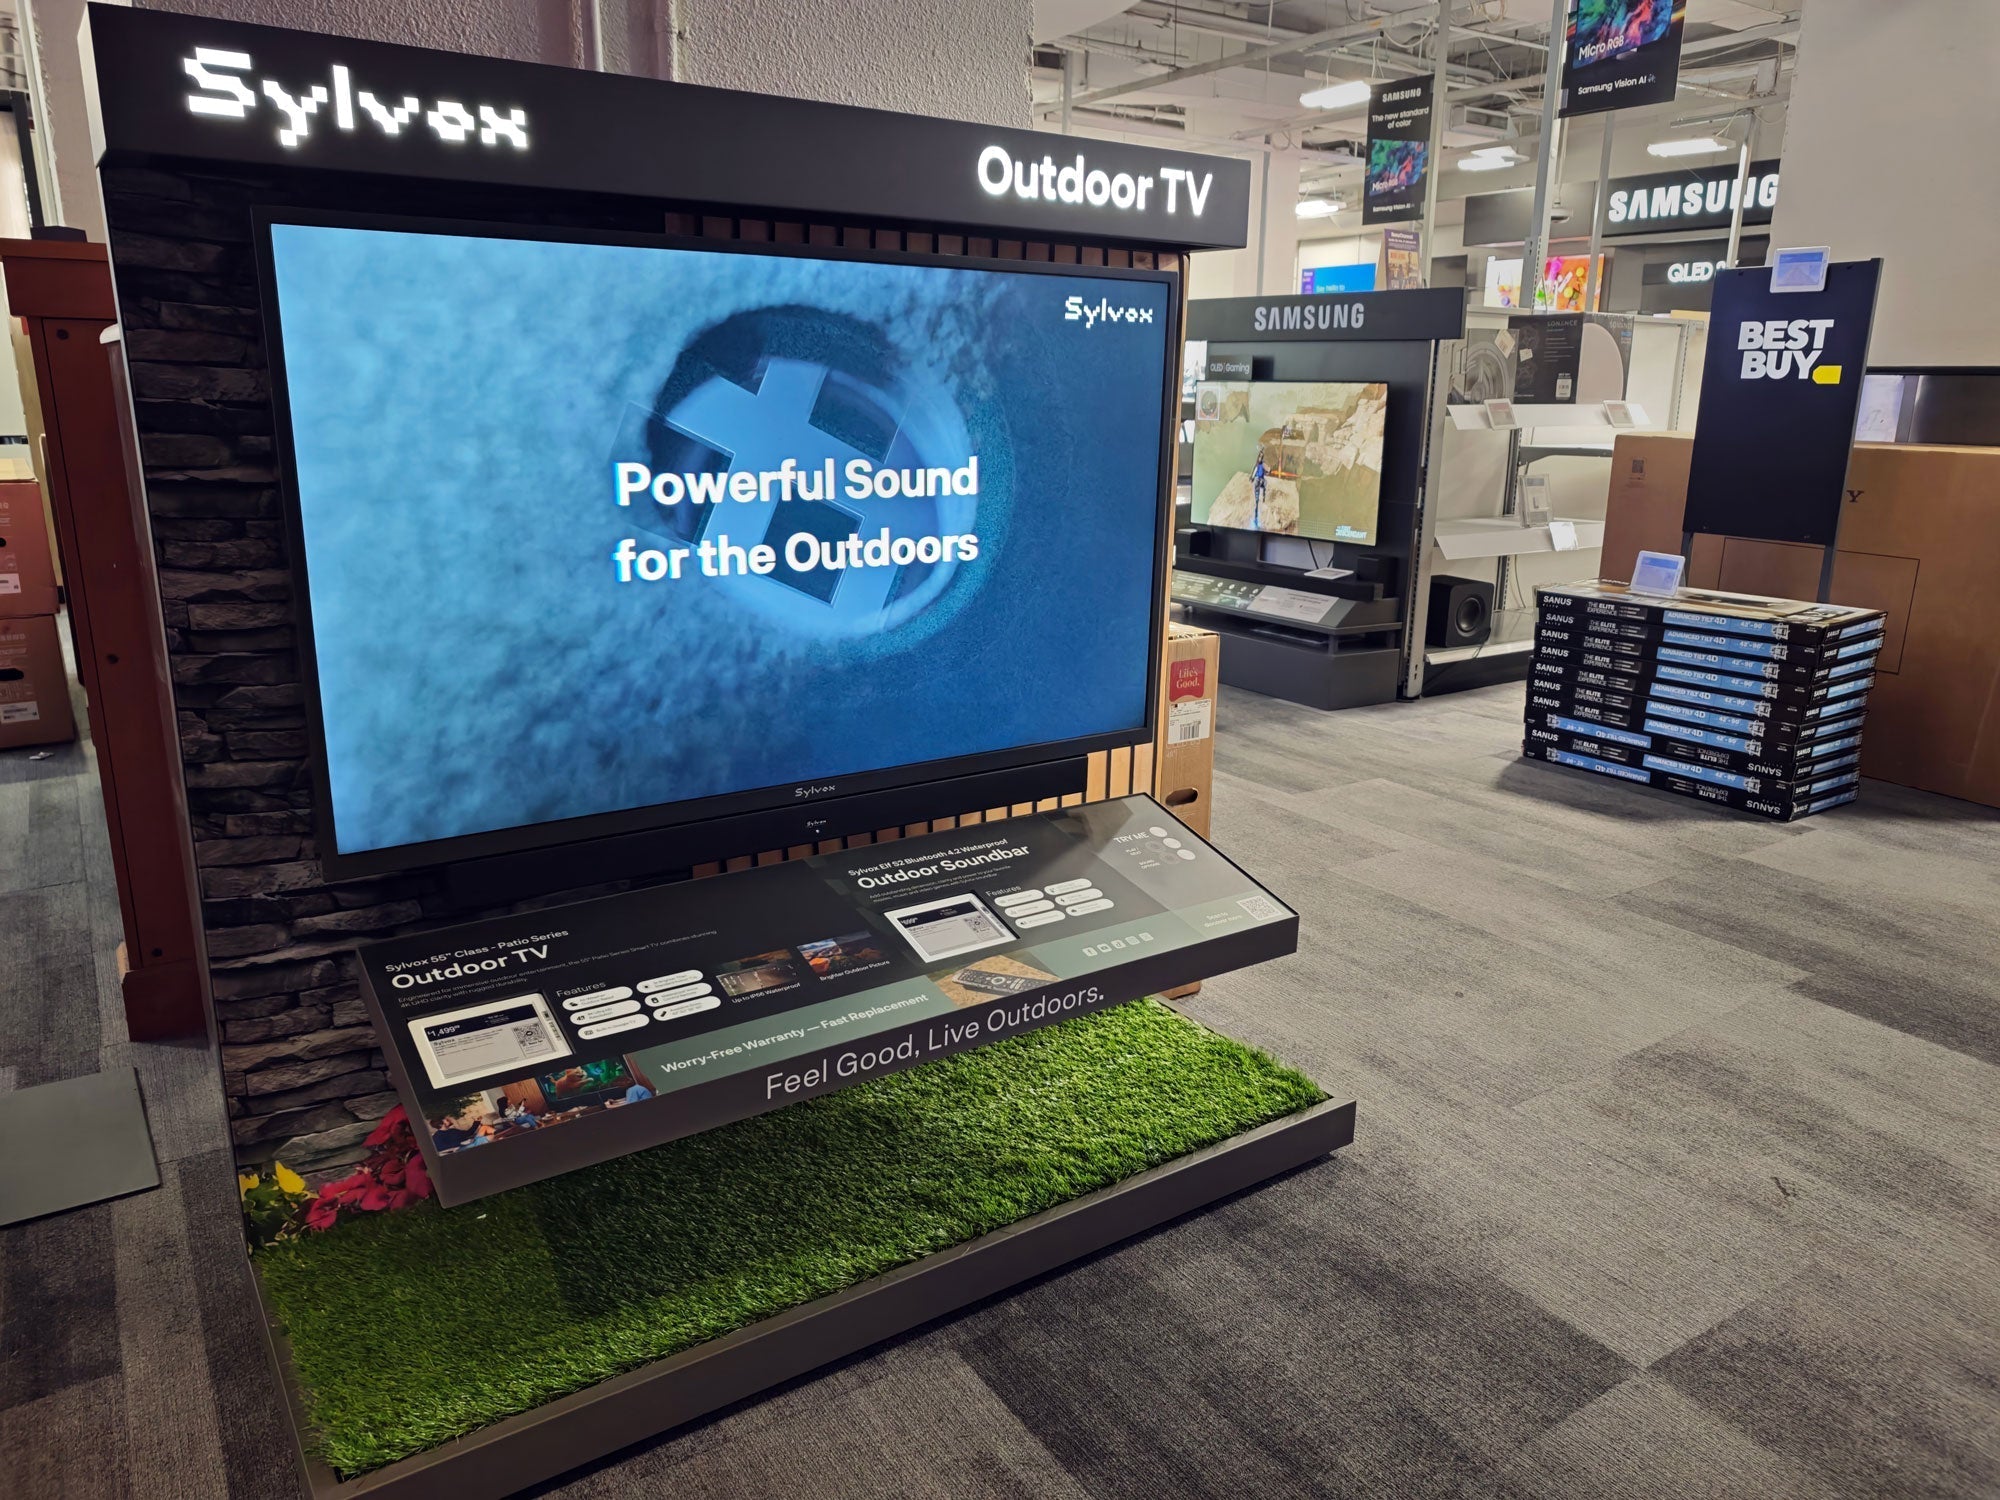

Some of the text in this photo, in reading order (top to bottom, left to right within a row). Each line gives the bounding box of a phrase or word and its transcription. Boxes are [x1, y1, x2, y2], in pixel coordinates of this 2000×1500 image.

[1578, 35, 1624, 60] Micro RGB
[1578, 76, 1646, 94] Samsung Vision AI
[183, 46, 528, 148] Sylvox
[1382, 88, 1422, 102] SAMSUNG
[1372, 106, 1429, 122] The new standard
[1396, 119, 1412, 128] color
[978, 146, 1213, 216] Outdoor TV
[1372, 181, 1387, 192] Micro
[1608, 173, 1779, 222] SAMSUNG
[1668, 261, 1714, 283] QLED
[1064, 296, 1153, 328] Sylvox
[1254, 302, 1364, 331] SAMSUNG
[1738, 319, 1834, 350] BEST
[1226, 362, 1250, 374] Gaming
[1740, 350, 1822, 380] BUY
[614, 456, 978, 506] Powerful Sound
[612, 527, 979, 582] for the Outdoors
[1544, 596, 1572, 606] SANUS
[1546, 613, 1574, 624] SANUS
[1541, 629, 1570, 640] SANUS
[1541, 646, 1569, 657] SANUS
[1178, 668, 1198, 679] Life's
[1535, 663, 1563, 674] SANUS
[1176, 676, 1200, 689] Good.
[1534, 679, 1562, 691] SANUS
[1586, 689, 1601, 697] ELITE
[1533, 696, 1560, 707] SANUS
[1585, 707, 1600, 715] ELITE
[1532, 729, 1558, 742] SANUS
[1692, 729, 1703, 738] 4D
[1690, 764, 1702, 773] 4D
[1748, 762, 1782, 777] SANUS
[795, 785, 835, 798] Sylvox
[1746, 800, 1781, 814] SANUS
[1114, 831, 1149, 844] TRY ME
[848, 866, 878, 877] Sylvox
[904, 850, 948, 865] Bluetooth
[948, 848, 960, 857] 4.2
[960, 838, 1008, 853] Waterproof
[857, 864, 939, 889] Outdoor
[940, 844, 1030, 872] Soundbar
[986, 886, 1021, 897] Features
[385, 930, 568, 972] Sylvox 55" Class Patio Series
[392, 944, 548, 989] Outdoor TV
[820, 960, 890, 982] Brighter Outdoor Picture
[398, 990, 440, 1002] Engineered
[556, 982, 606, 997] Features
[764, 982, 800, 996] Waterproof
[661, 993, 928, 1073] Worry-Free Warranty Fast Replacement
[766, 986, 1104, 1100] Feel Good, Live Outdoors.
